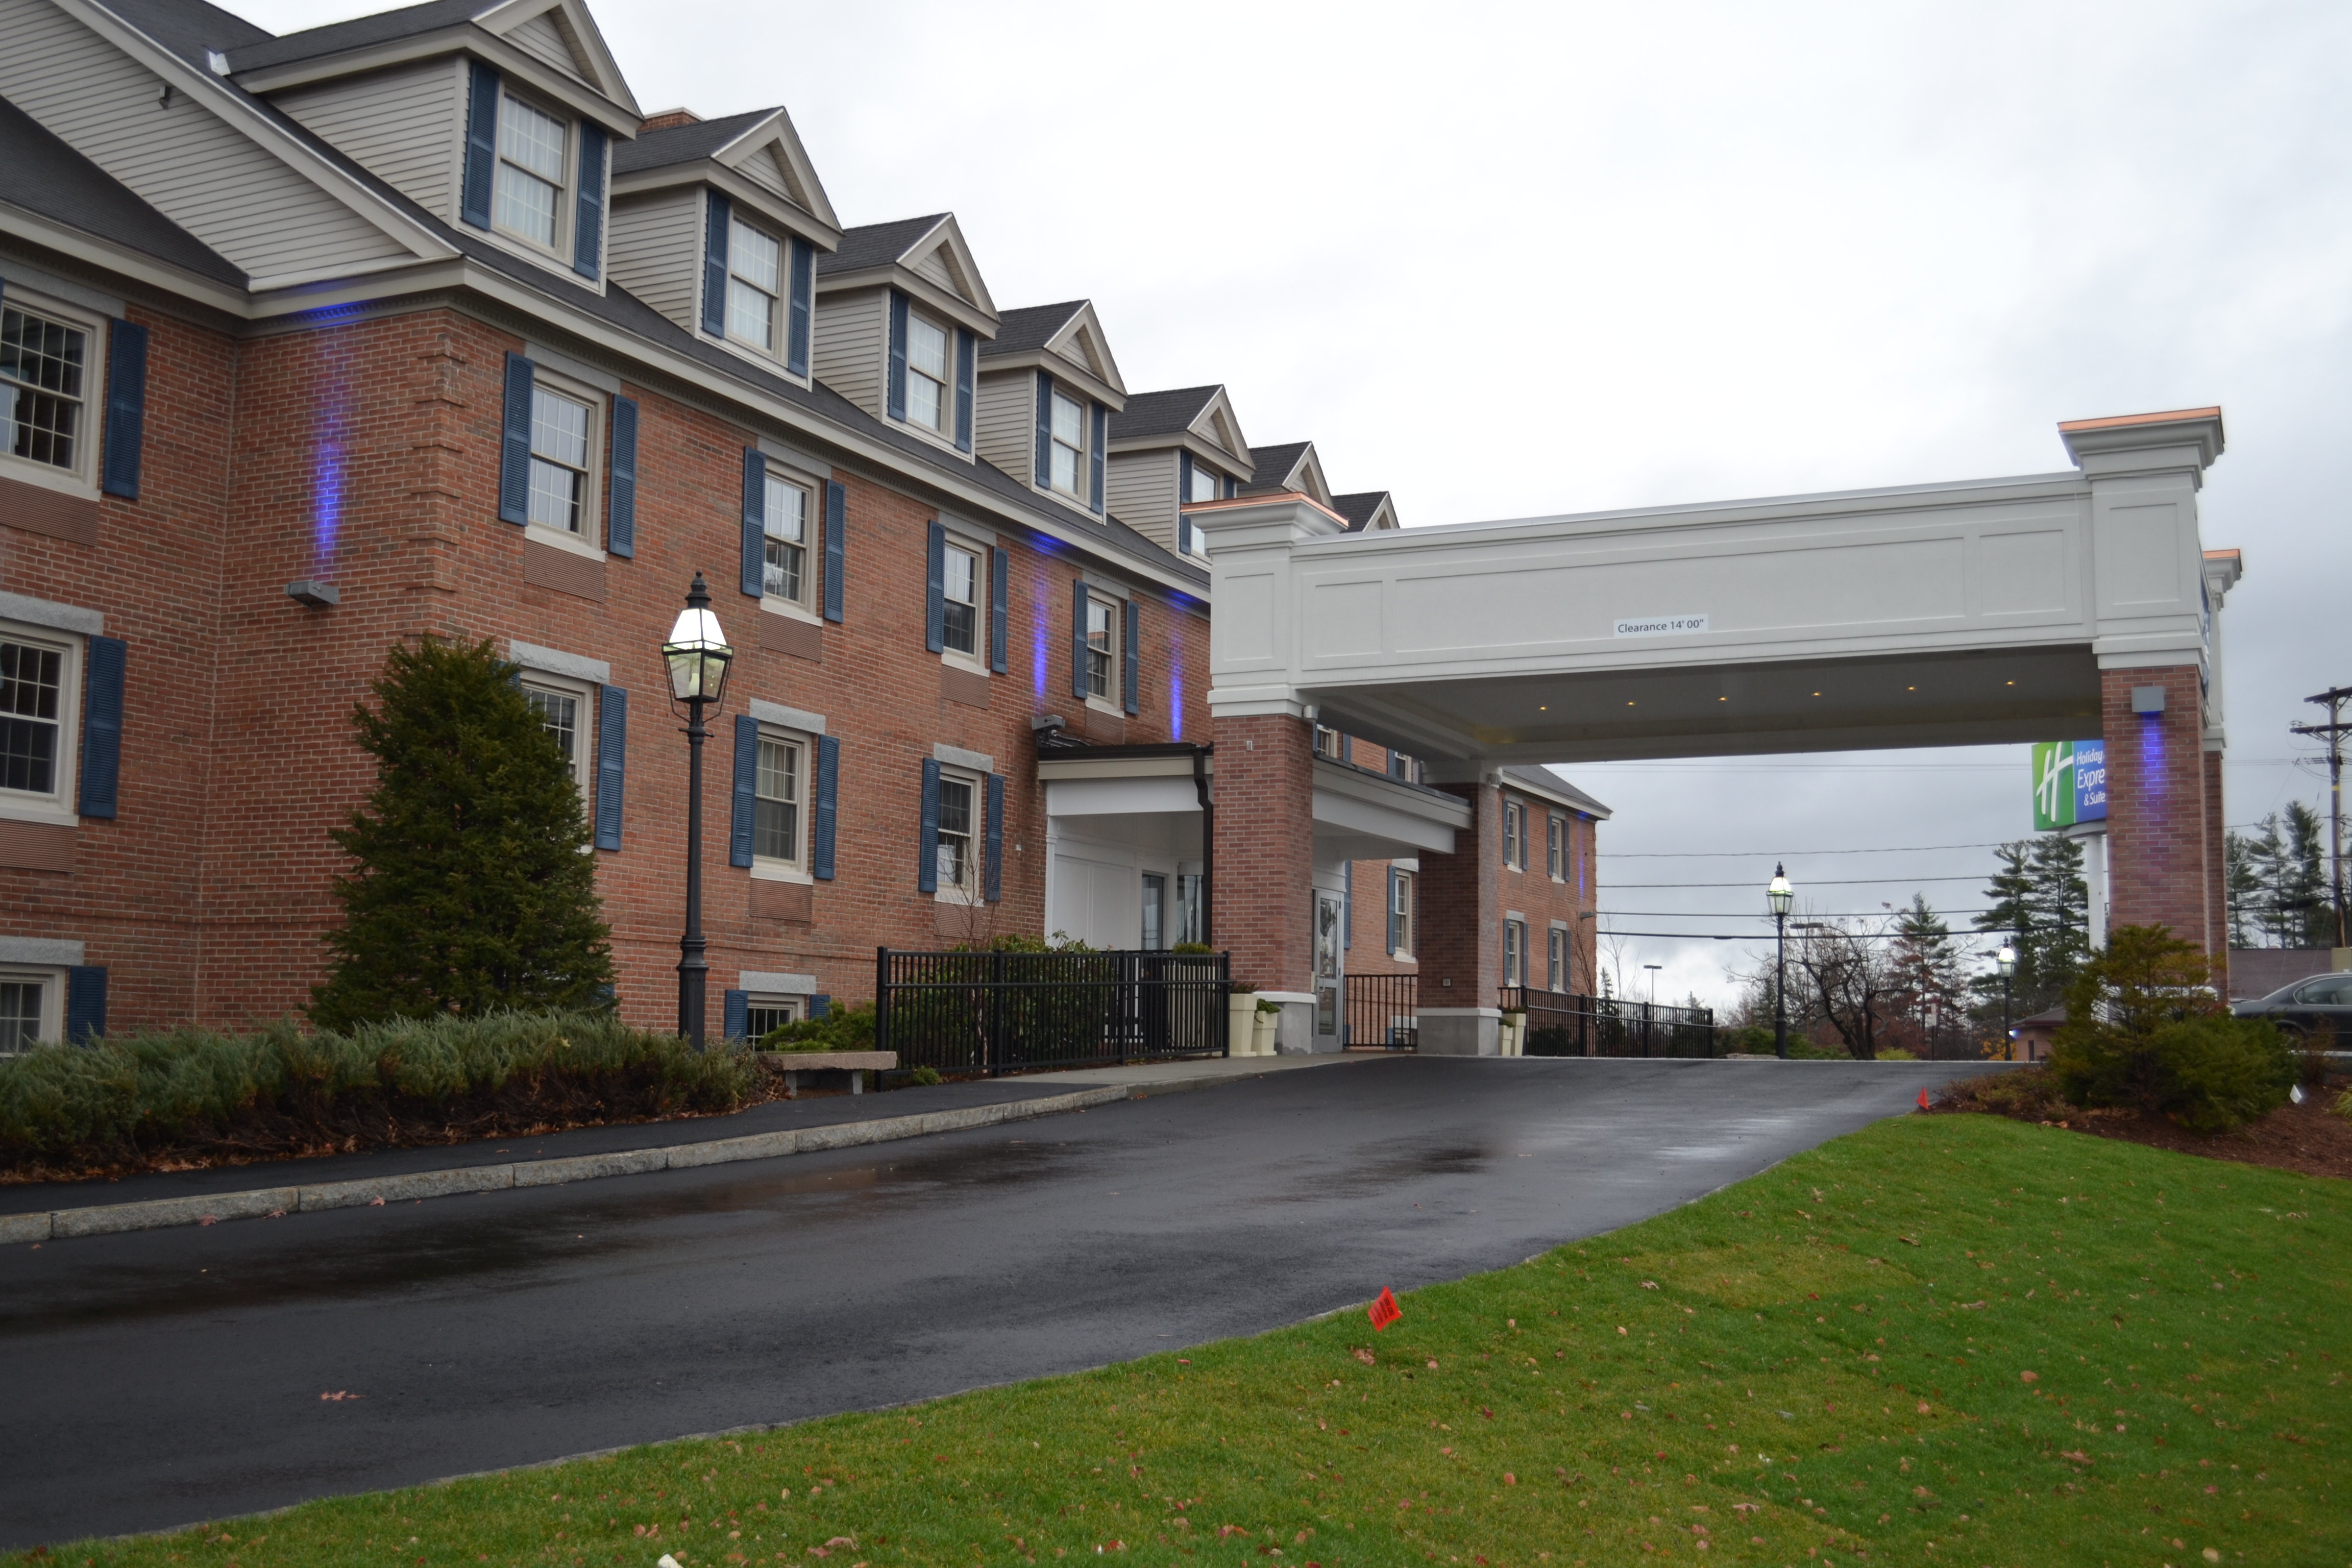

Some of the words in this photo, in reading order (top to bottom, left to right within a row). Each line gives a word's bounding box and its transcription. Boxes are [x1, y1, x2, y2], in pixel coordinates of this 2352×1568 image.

[1618, 623, 1667, 633] Clearance
[1670, 620, 1684, 630] 14'
[1686, 619, 1704, 629] 00"
[2076, 748, 2102, 765] Holiday
[2084, 793, 2089, 806] &
